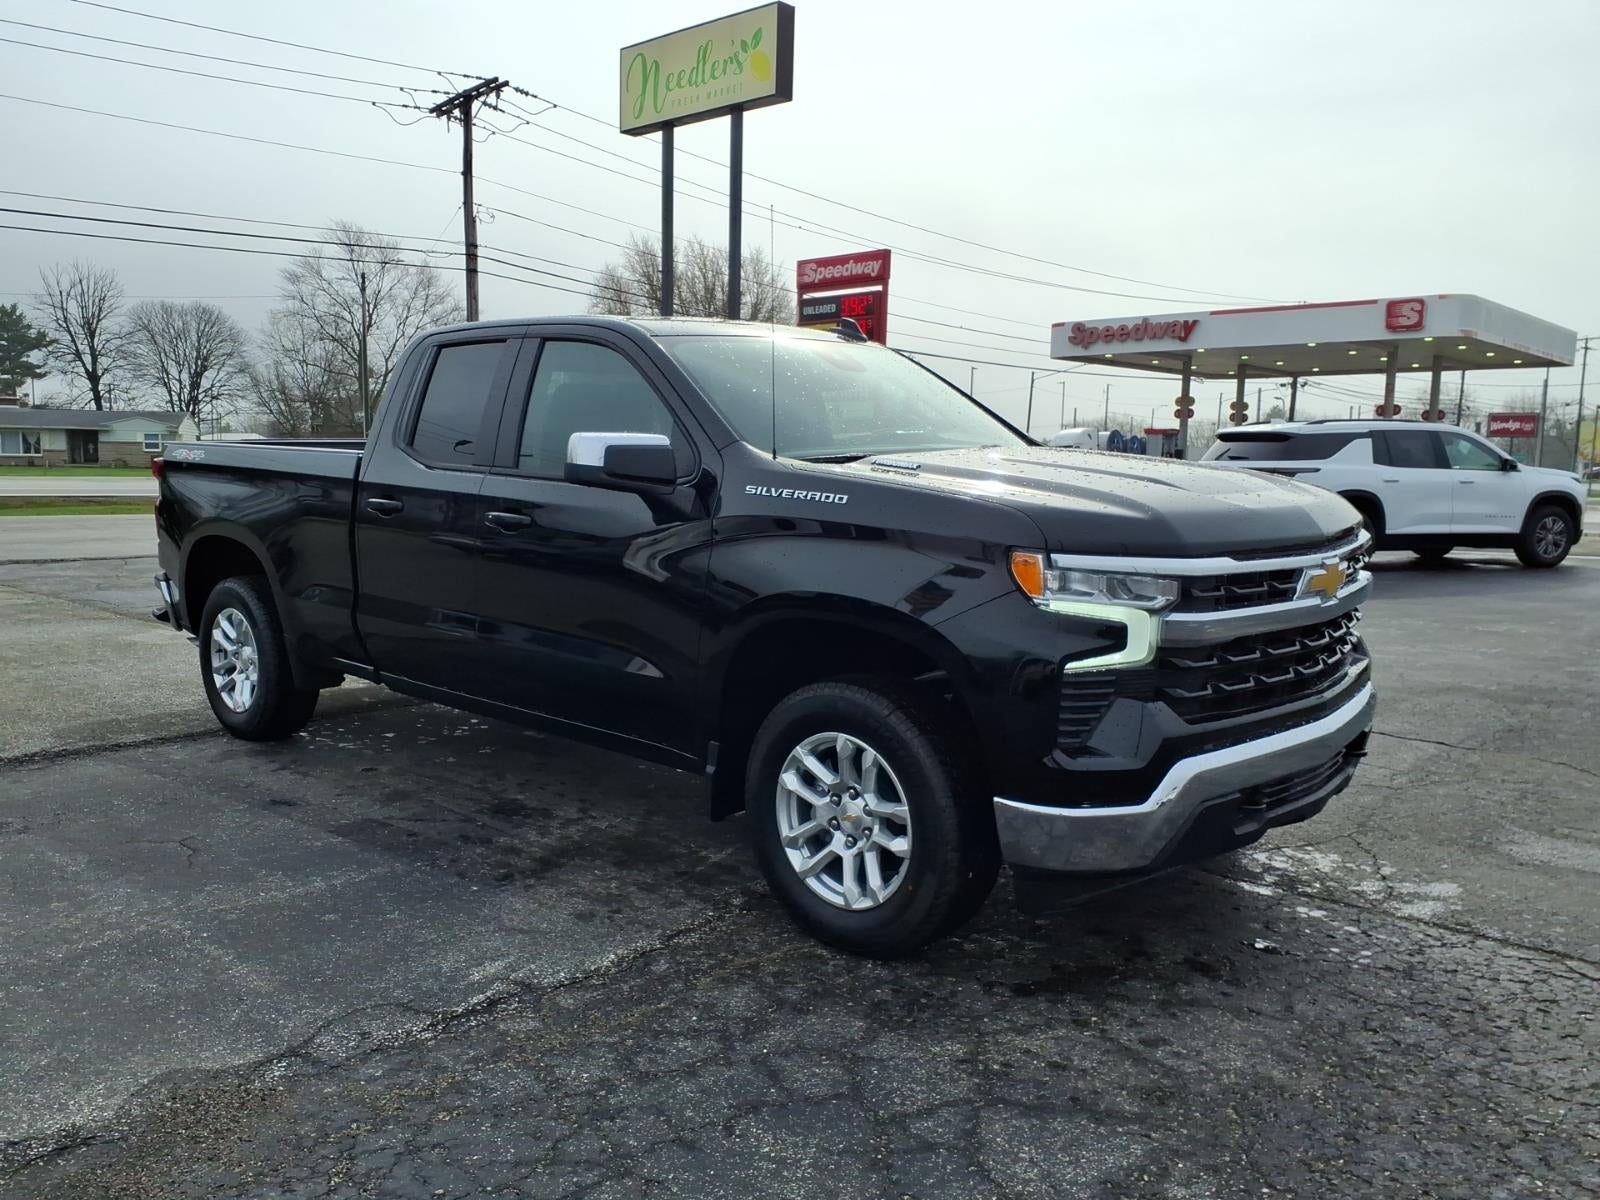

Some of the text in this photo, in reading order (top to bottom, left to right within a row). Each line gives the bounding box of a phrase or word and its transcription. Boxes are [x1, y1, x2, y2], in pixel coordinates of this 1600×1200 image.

[626, 39, 744, 120] Needler's
[803, 259, 882, 283] Speedway
[803, 303, 837, 316] UNLEADED
[1067, 317, 1200, 350] Speedway
[744, 484, 849, 505] SILVERADO
